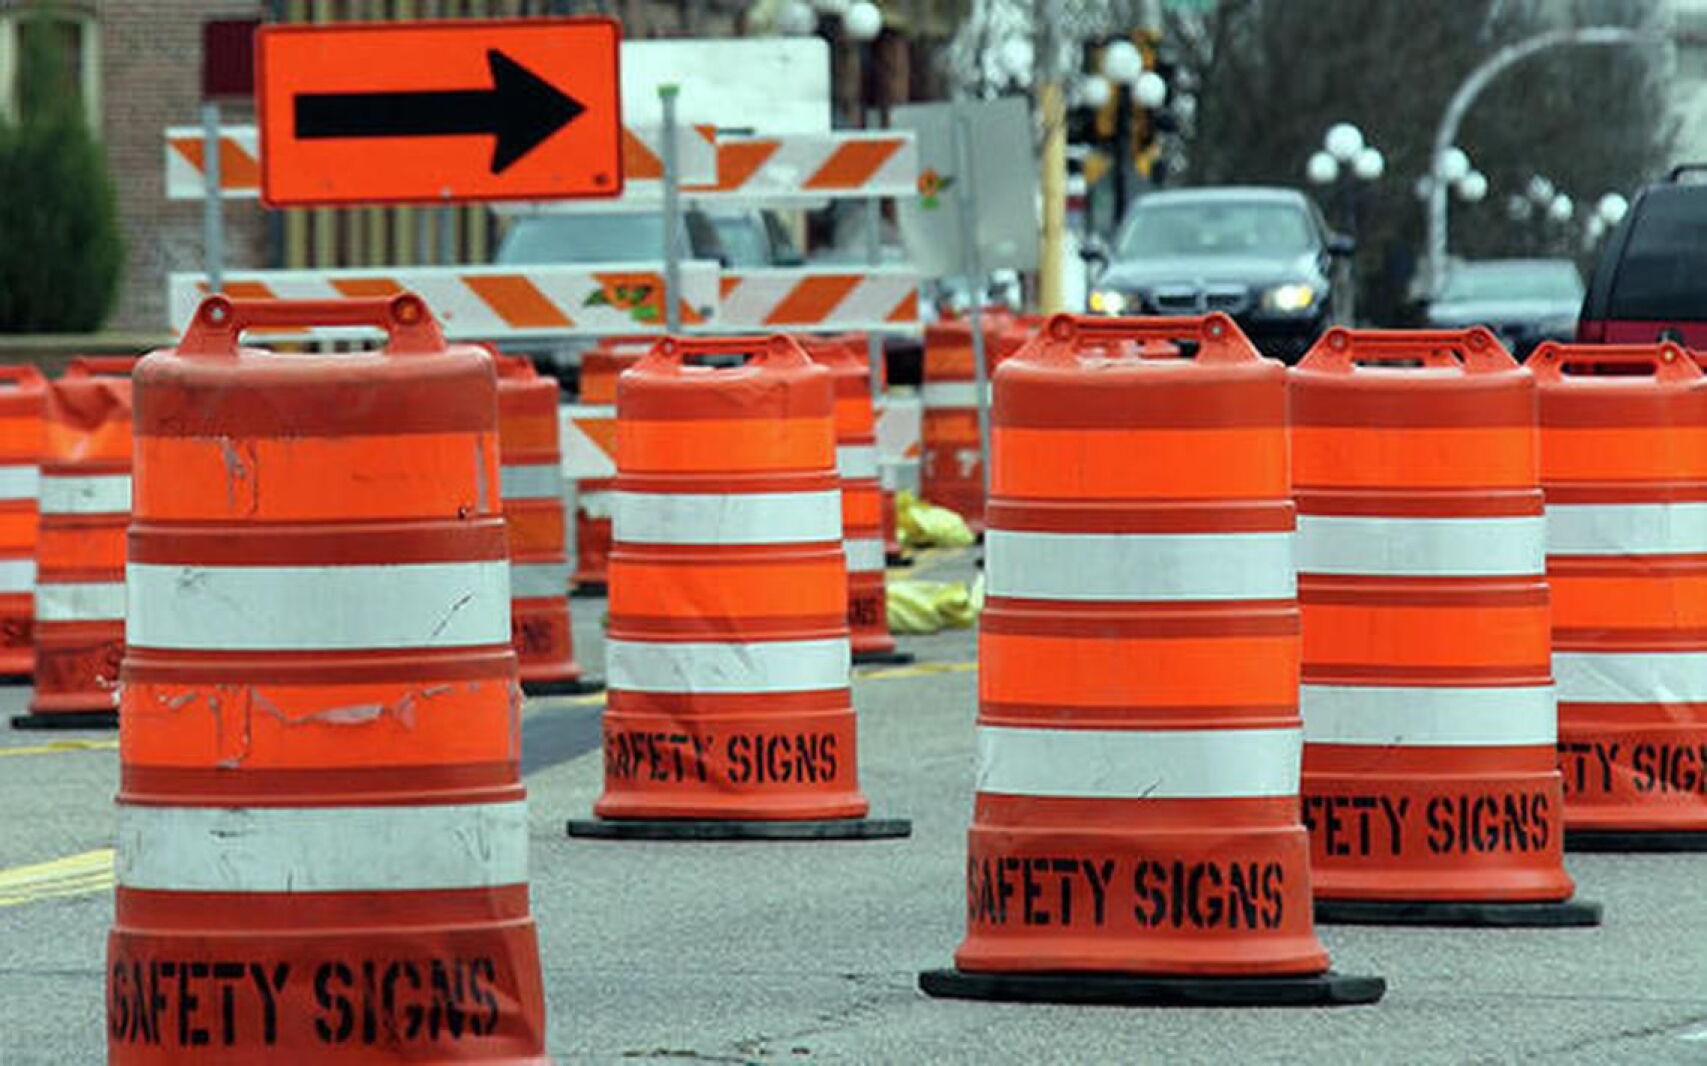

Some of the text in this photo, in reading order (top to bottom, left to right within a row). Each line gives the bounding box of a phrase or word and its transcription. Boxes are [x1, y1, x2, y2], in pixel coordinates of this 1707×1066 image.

[727, 733, 837, 783] SIGNS
[1427, 794, 1549, 854] SIGNS
[967, 857, 1284, 929] SAFETY SIGNS
[112, 957, 498, 1045] SAFETY SIGNS
